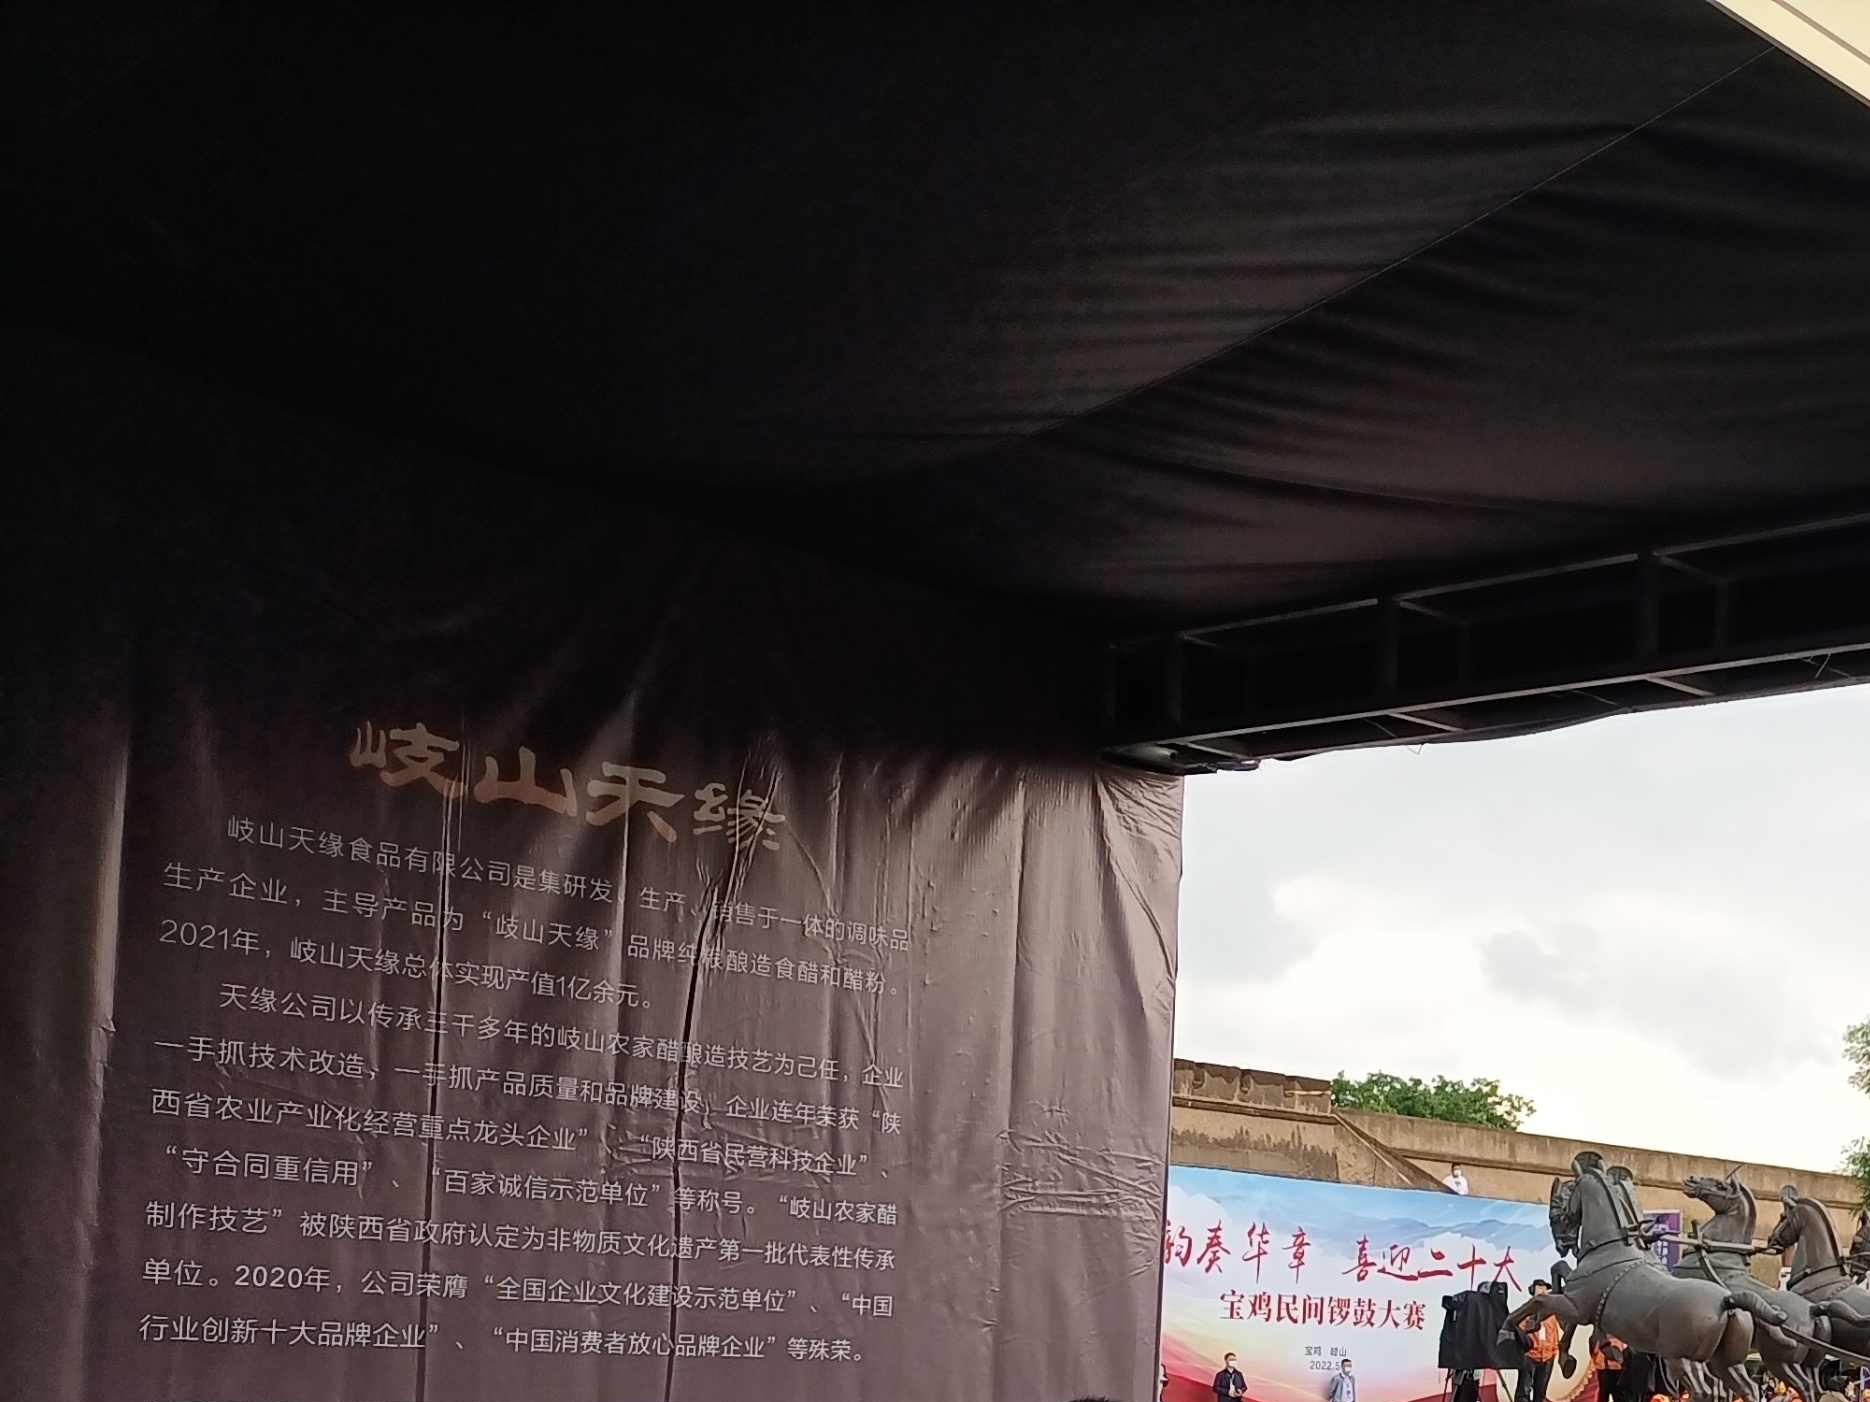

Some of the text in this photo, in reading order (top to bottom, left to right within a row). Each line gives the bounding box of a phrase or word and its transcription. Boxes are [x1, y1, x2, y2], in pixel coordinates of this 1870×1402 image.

[350, 719, 785, 851] 岐山天缘
[1341, 1235, 1523, 1293] 喜迎二十大
[1219, 1290, 1428, 1332] 宝鸡民间锣鼓大赛
